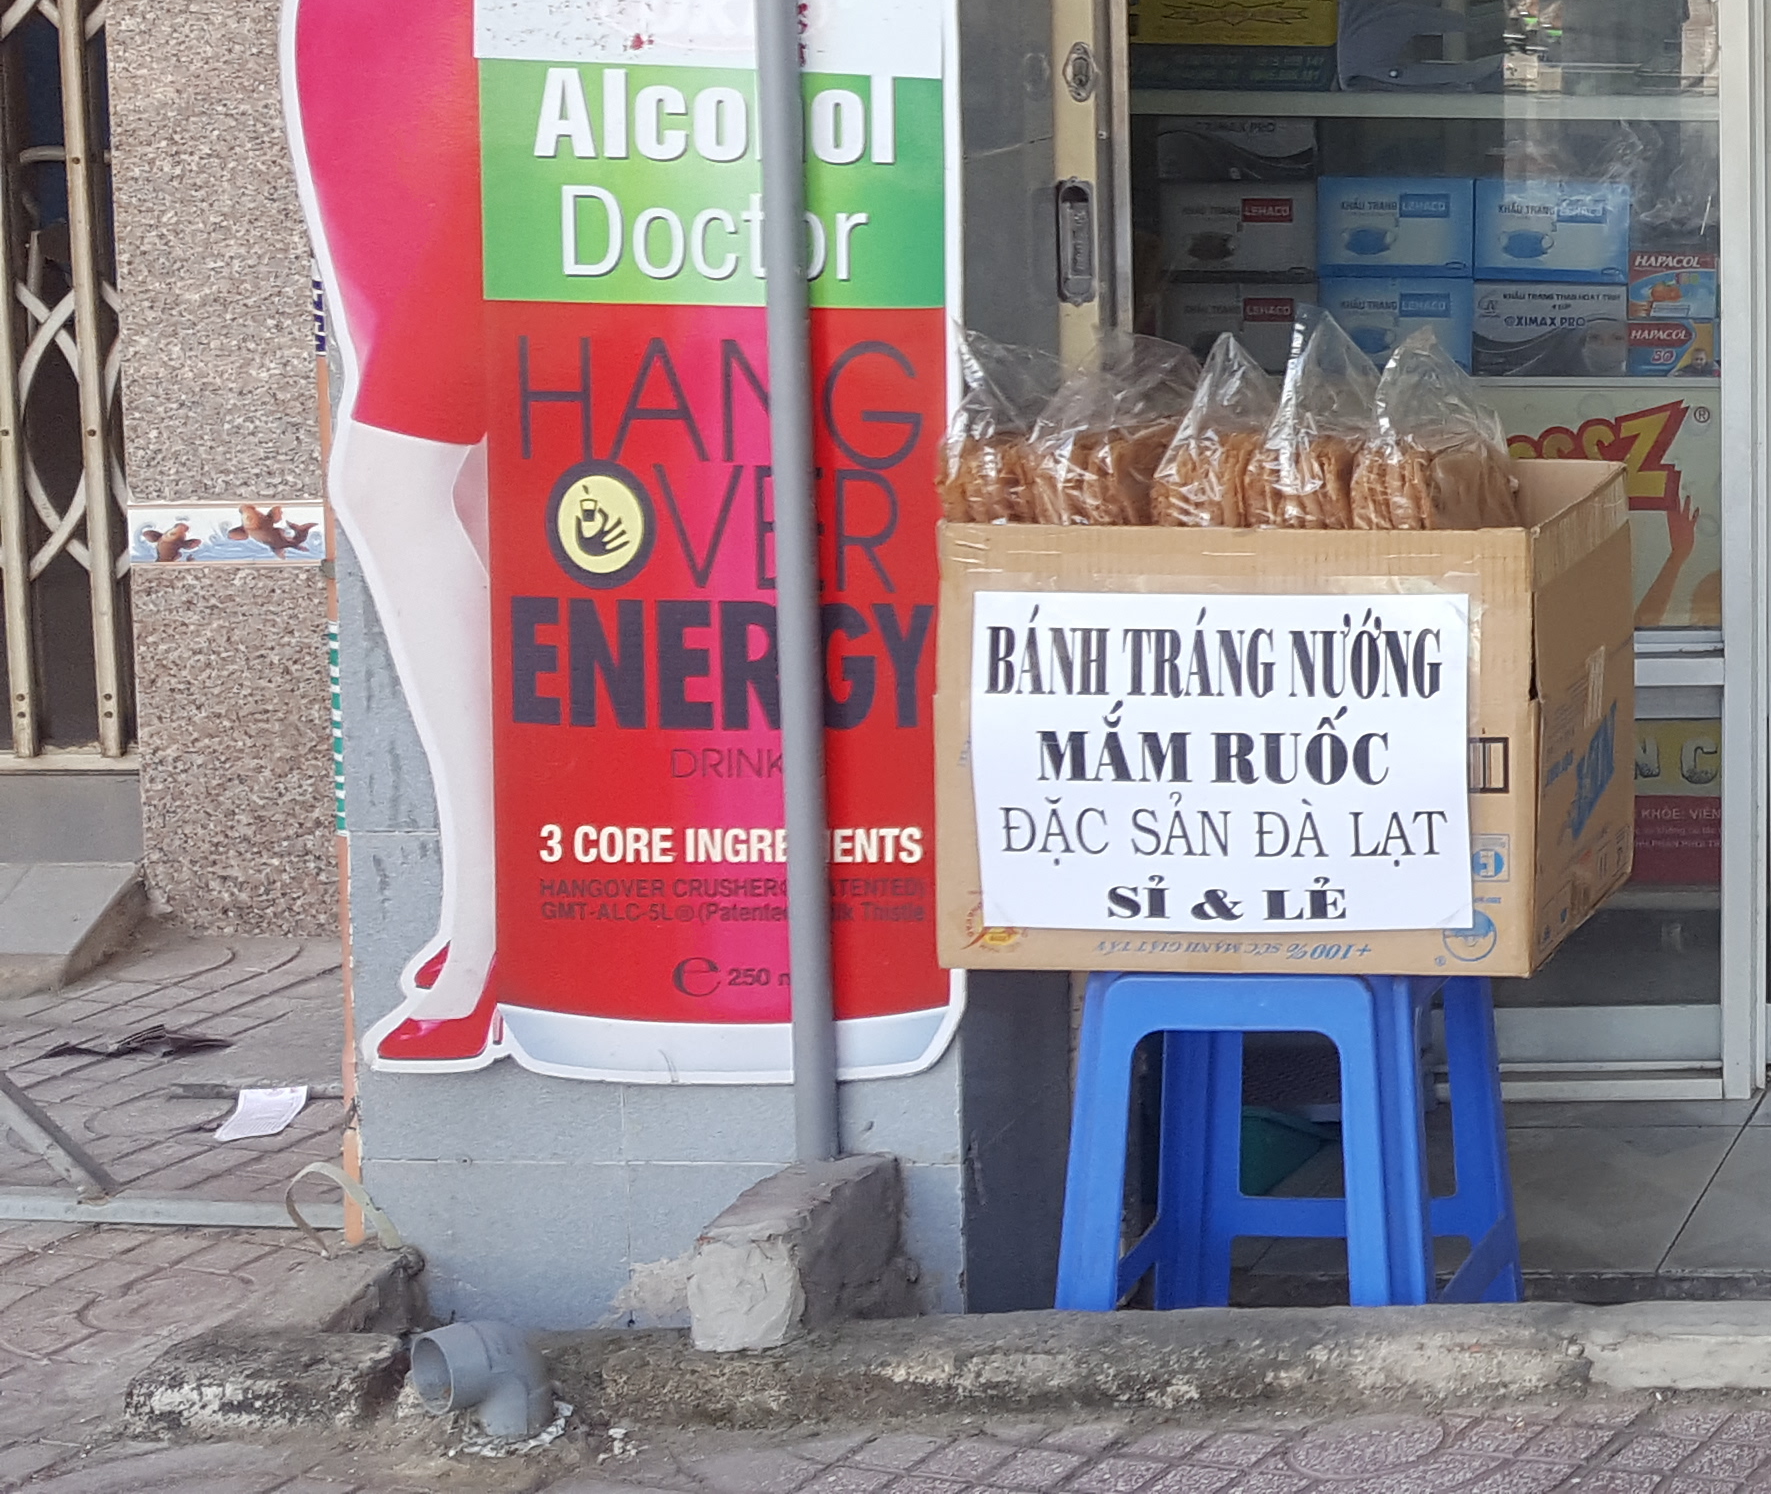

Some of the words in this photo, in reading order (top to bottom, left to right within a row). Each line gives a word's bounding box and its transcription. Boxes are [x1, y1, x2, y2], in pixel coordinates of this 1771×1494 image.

[534, 68, 895, 164] Alcool
[1245, 206, 1290, 217] LEHACO
[1635, 255, 1701, 268] HAPACOL
[1246, 306, 1291, 316] LEHACO
[1560, 317, 1587, 328] PRO
[1630, 329, 1689, 340] HAPACOL
[519, 336, 922, 469] HANG
[512, 596, 933, 730] ENERGY
[984, 604, 1110, 696] BÁNH
[1123, 607, 1275, 699] TRÁNG
[1289, 608, 1442, 699] NƯỚNG
[1037, 700, 1192, 783] MẮM
[1210, 706, 1389, 786] RUỐC
[540, 824, 562, 864] 3
[574, 826, 674, 864] CORE
[686, 827, 922, 864] INGREIENTS
[999, 797, 1109, 866] ĐẶC
[1130, 792, 1231, 858] SẢN
[1254, 798, 1329, 858] ĐÀ
[1349, 810, 1448, 867] LẠT
[541, 879, 664, 899] HANGOVER
[1107, 874, 1171, 921] SỈ
[1190, 889, 1244, 921] &
[1262, 877, 1346, 920] LẺ
[1286, 942, 1372, 961] +100%
[728, 967, 769, 987] 250
